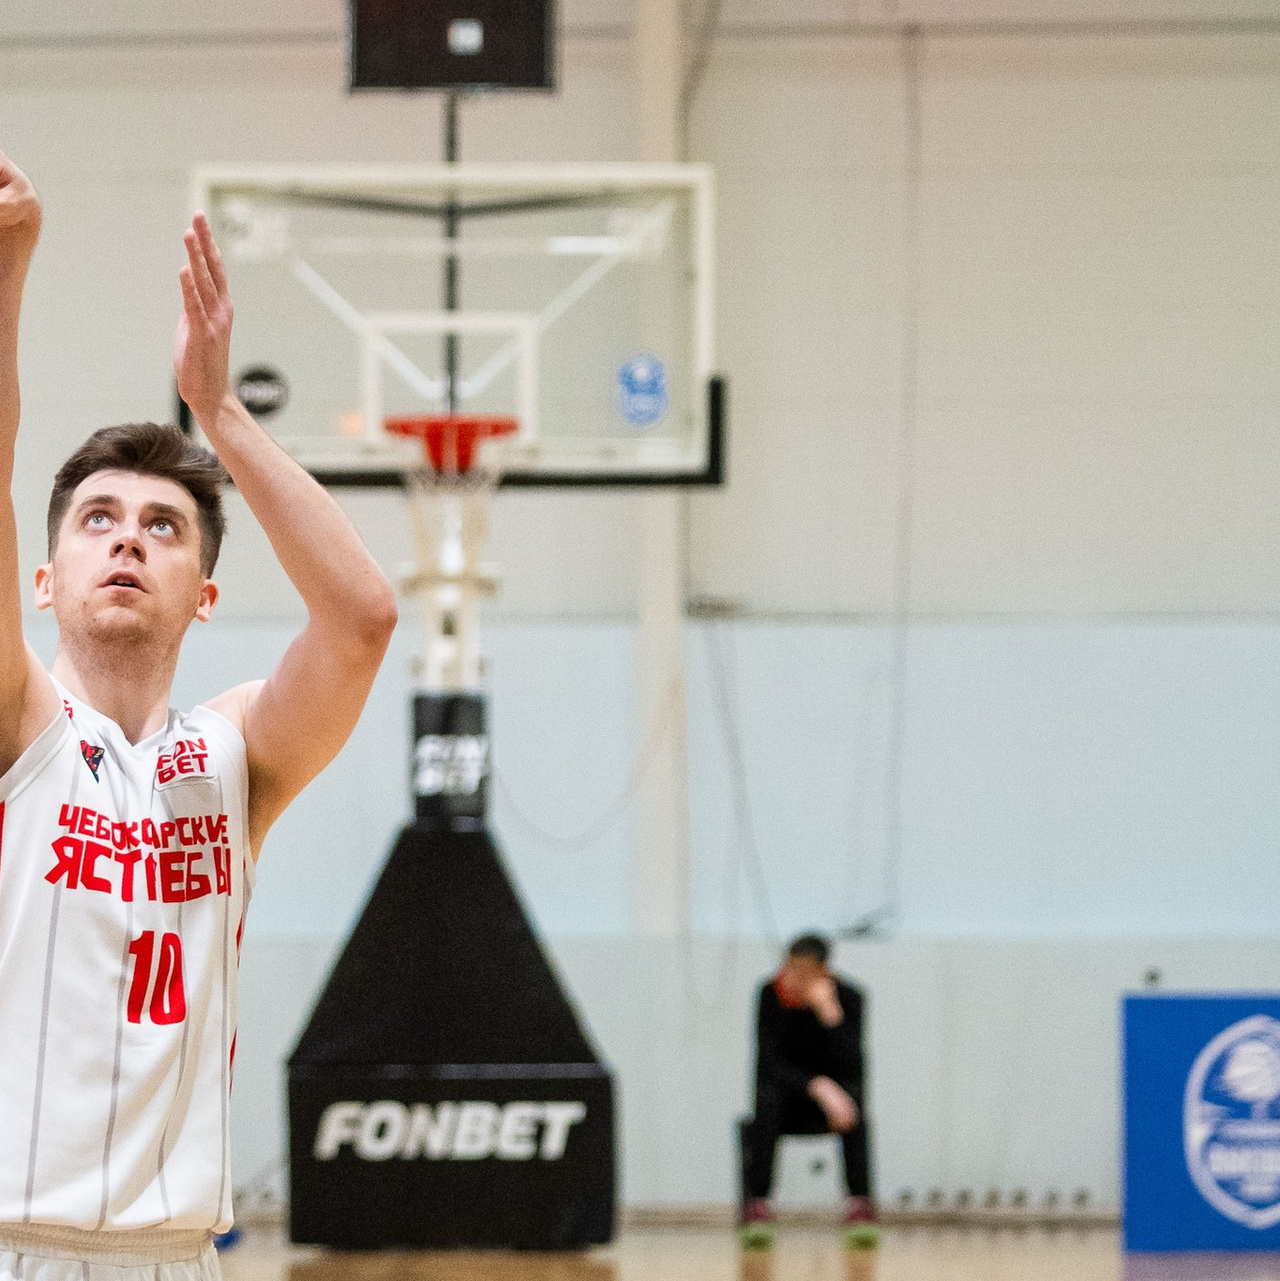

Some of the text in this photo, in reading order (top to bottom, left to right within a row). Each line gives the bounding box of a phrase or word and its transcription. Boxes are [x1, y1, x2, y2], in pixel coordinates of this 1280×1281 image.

[158, 753, 208, 784] BET
[127, 930, 187, 1025] 10
[314, 1100, 587, 1161] FONBET
